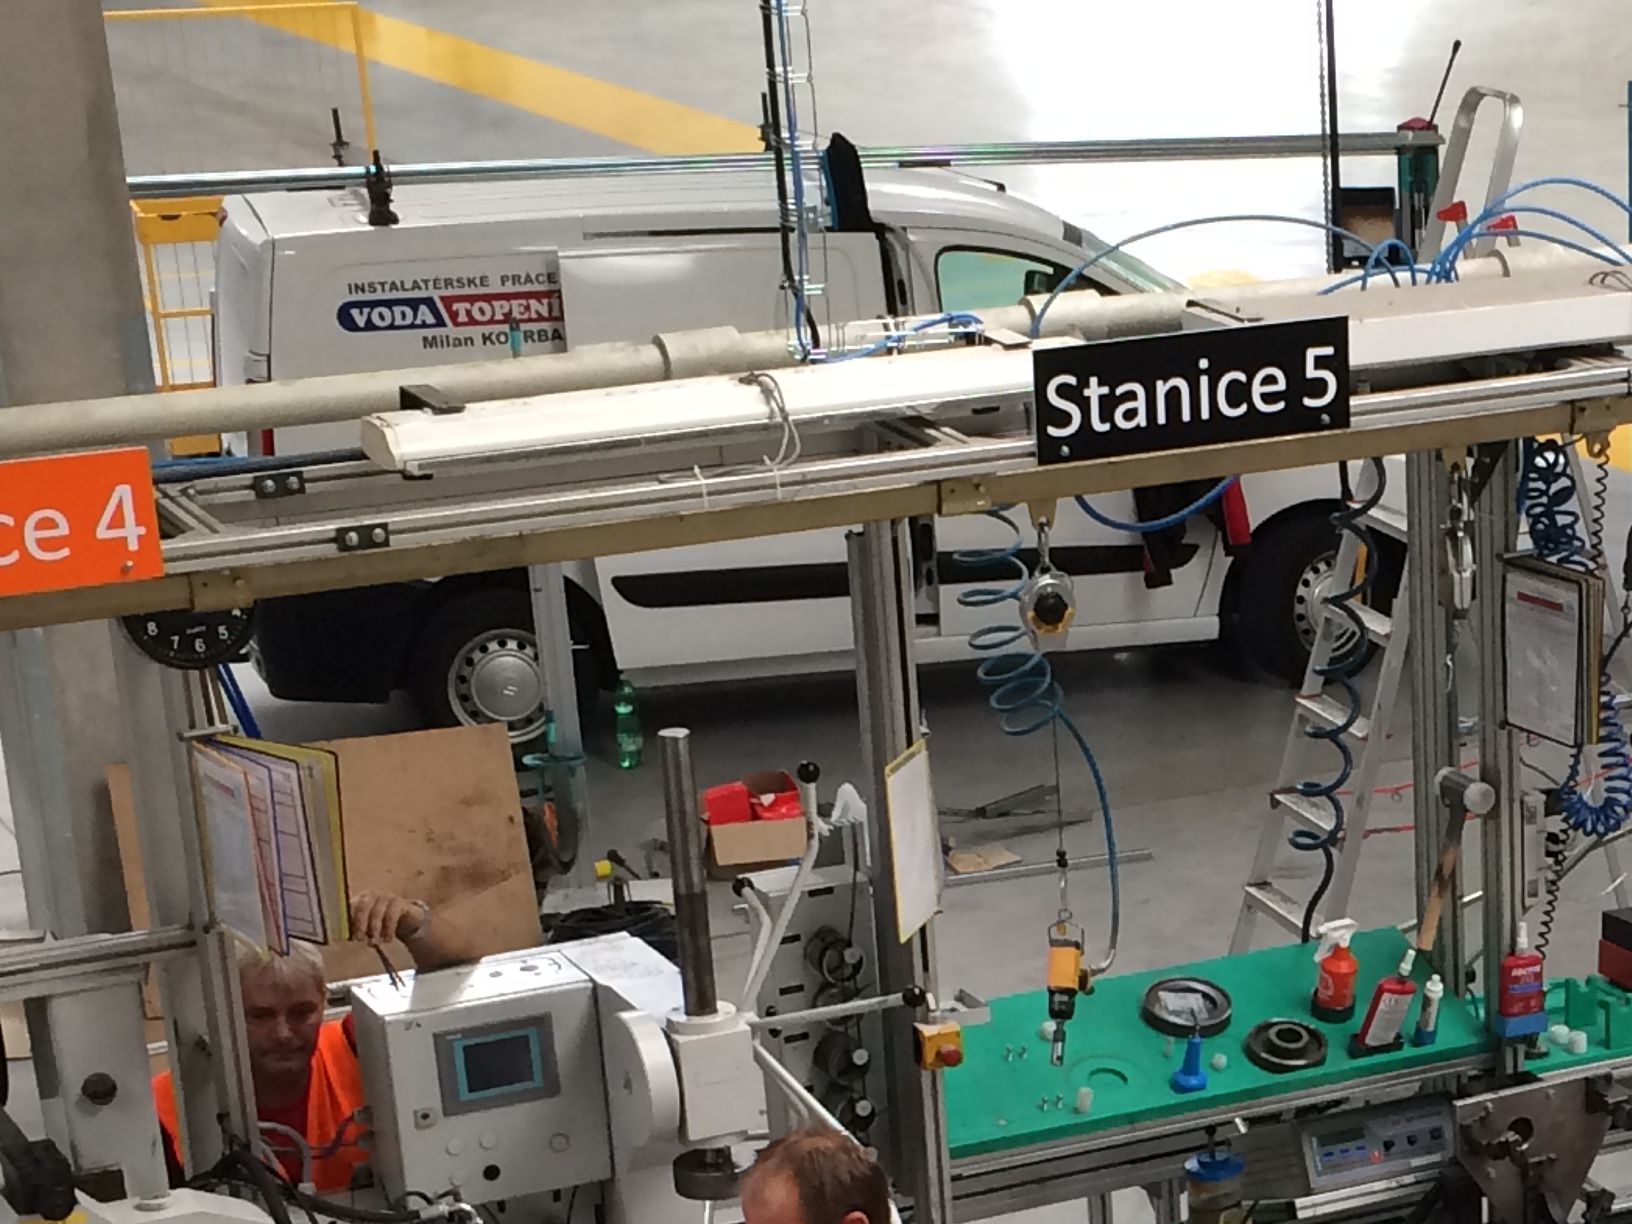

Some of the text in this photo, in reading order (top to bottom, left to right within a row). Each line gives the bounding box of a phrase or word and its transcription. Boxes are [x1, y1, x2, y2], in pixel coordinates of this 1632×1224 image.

[348, 270, 559, 295] INSTALATÉRSKÉ PRÁCE
[350, 293, 563, 328] VODA TOPENÍ
[422, 327, 565, 350] Milan KORBA
[1046, 345, 1338, 438] Stanice 5
[95, 483, 147, 552] 4
[147, 621, 158, 636] 8
[194, 638, 206, 653] 6
